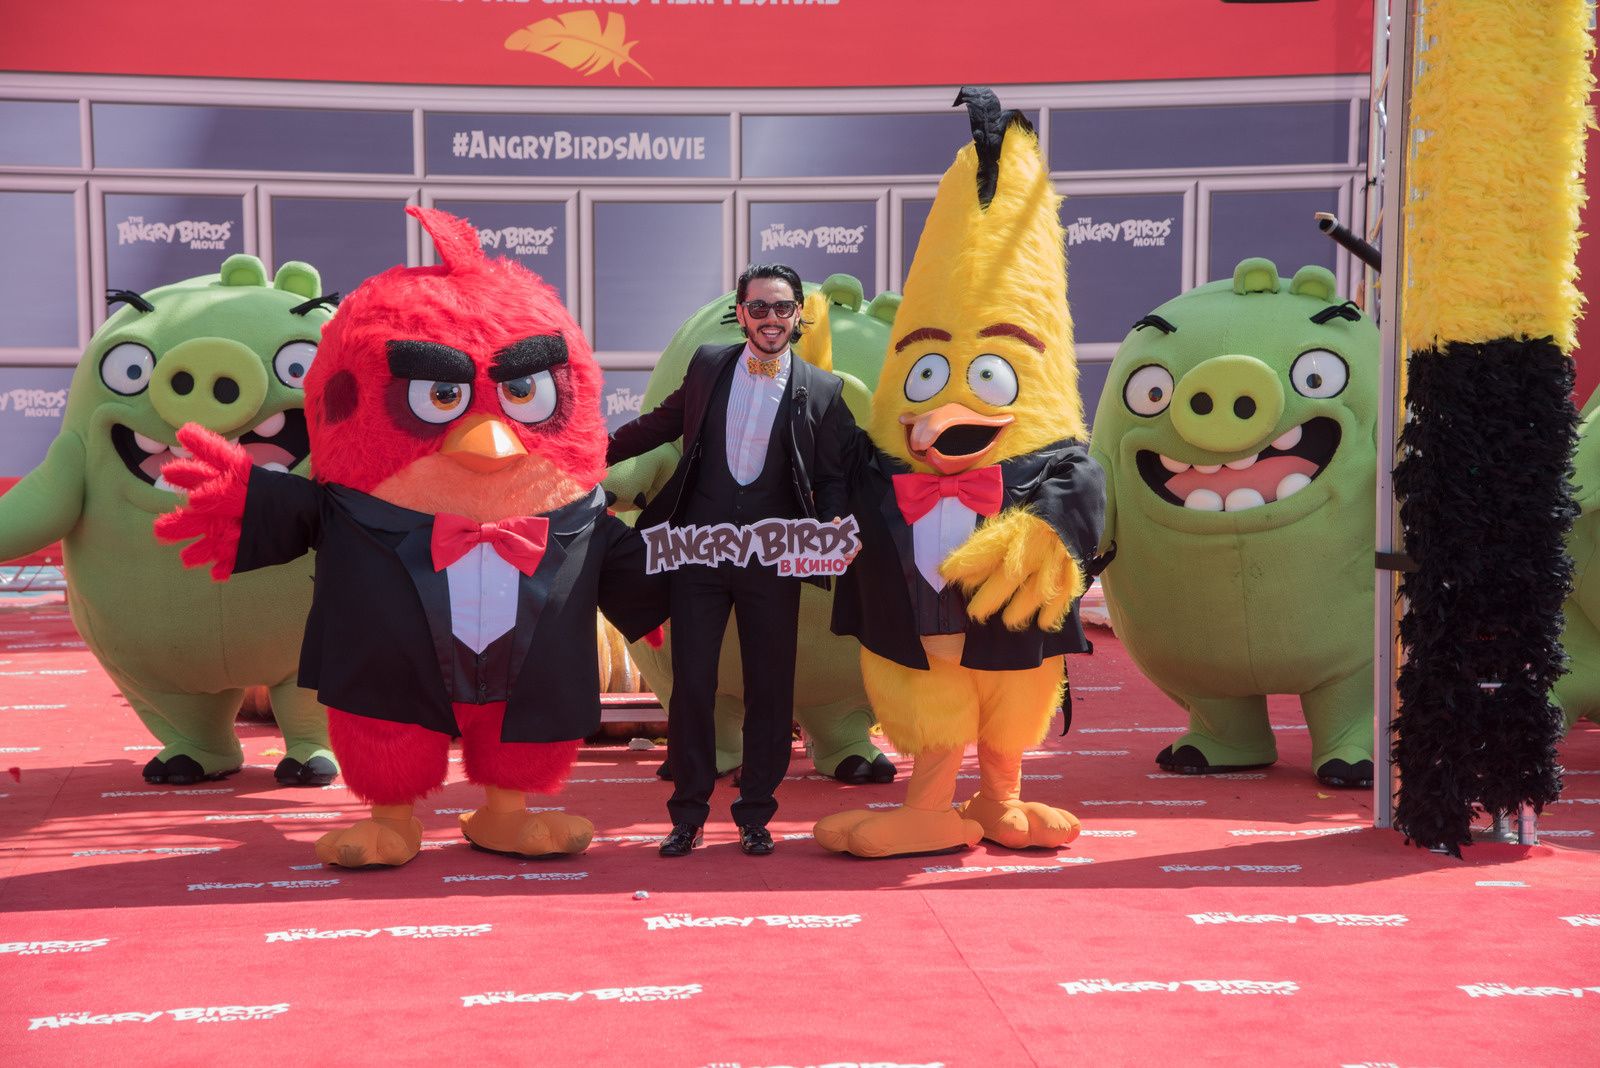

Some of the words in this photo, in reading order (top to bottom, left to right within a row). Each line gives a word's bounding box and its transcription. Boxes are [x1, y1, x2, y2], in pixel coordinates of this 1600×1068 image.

[117, 221, 176, 245] ANGRY
[175, 220, 231, 243] BIRDS
[501, 226, 554, 249] BIRDS
[761, 228, 814, 252] ANGRY
[813, 225, 864, 248] BIRDS
[1067, 222, 1121, 246] ANGRY
[1120, 218, 1171, 241] BIRDS
[190, 240, 225, 249] MOVIE
[515, 245, 548, 255] MOVIE
[826, 244, 858, 253] MOVIE
[1133, 237, 1165, 247] MOVIE
[8, 389, 66, 411] BIRDS
[24, 407, 60, 417] MOVIE
[646, 526, 753, 571] ANGRY
[753, 520, 856, 562] BIRDS
[643, 915, 754, 930] ANGRY
[755, 914, 862, 927] BIRDS
[264, 928, 381, 943] ANGRY
[383, 924, 493, 937] BIRDS
[18, 947, 93, 956] MOVIE
[460, 991, 583, 1007] ANGRY
[584, 984, 703, 1000] BIRDS
[1058, 981, 1180, 995] ANGRY
[1180, 980, 1300, 992] BIRDS
[619, 994, 691, 1003] MOVIE
[28, 1012, 163, 1030] ANGRY
[166, 1003, 291, 1021] BIRDS
[196, 1014, 274, 1023] MOVIE
